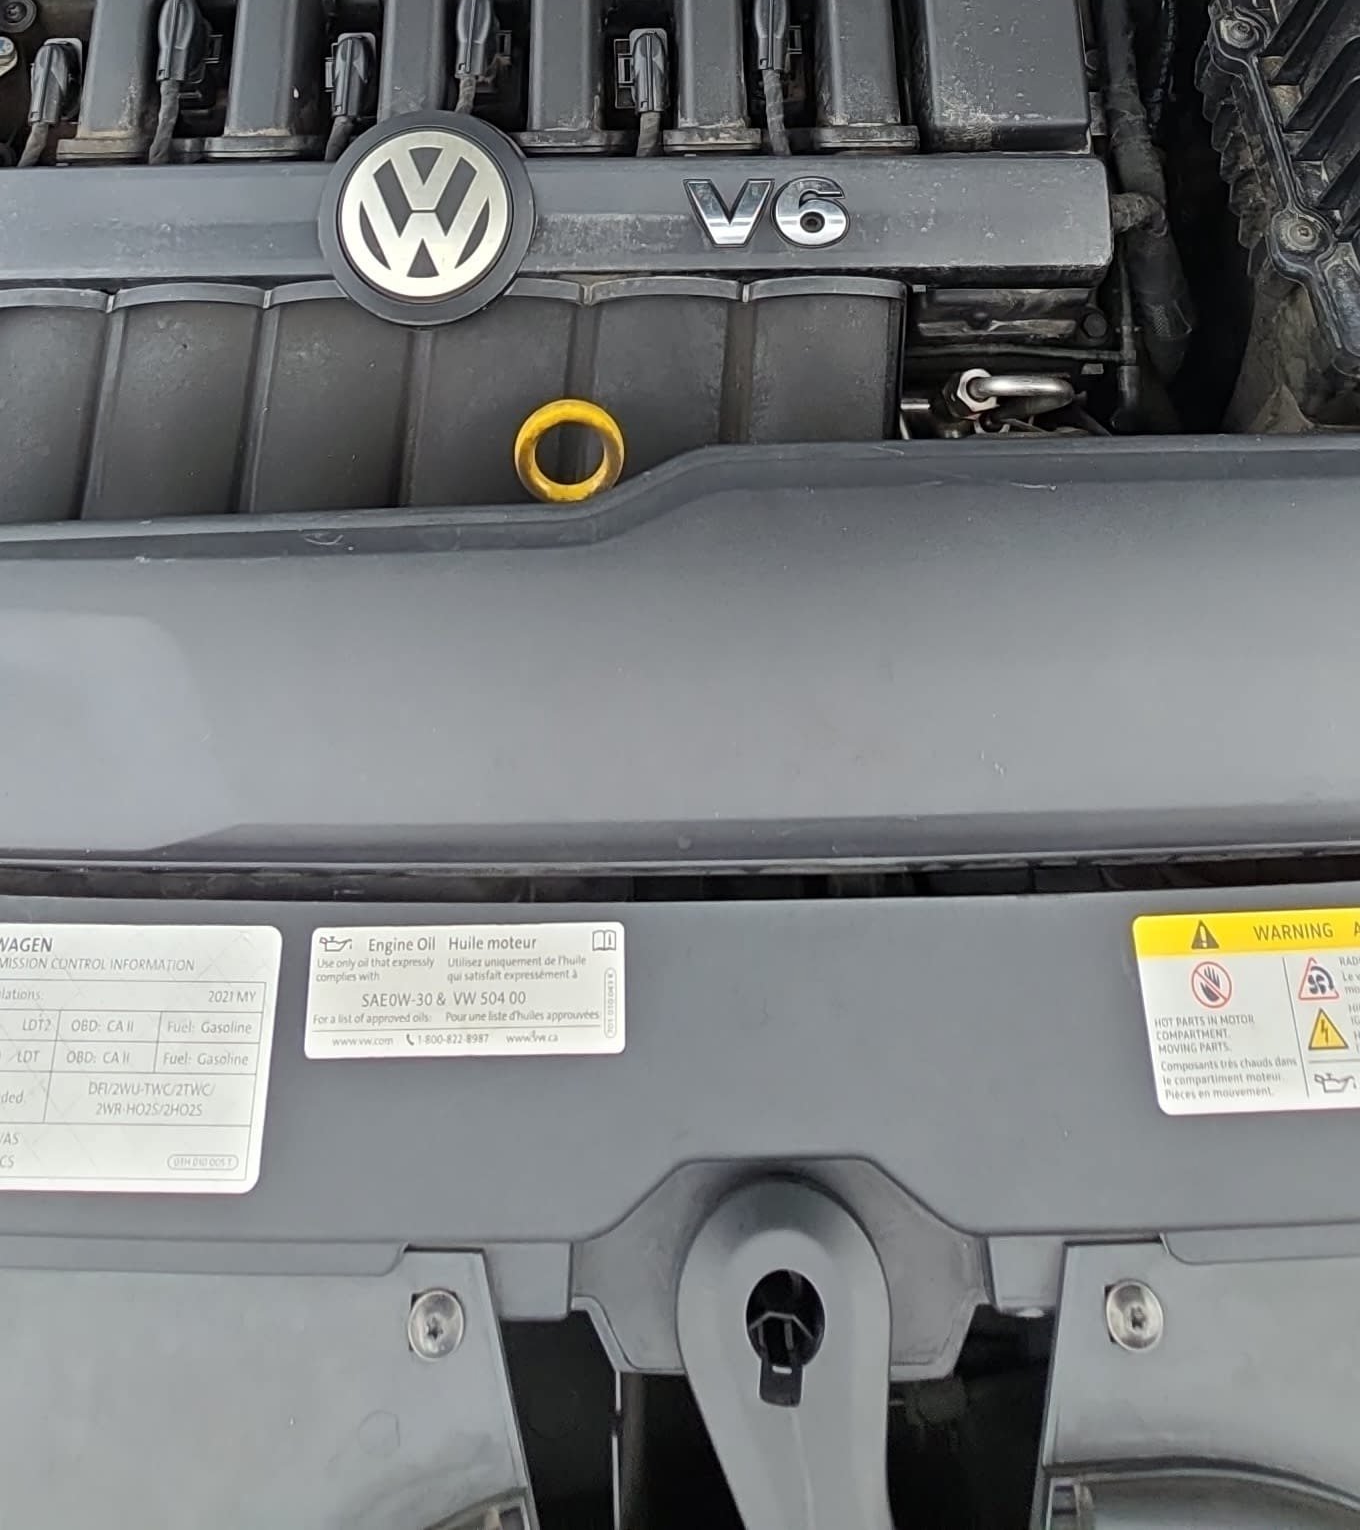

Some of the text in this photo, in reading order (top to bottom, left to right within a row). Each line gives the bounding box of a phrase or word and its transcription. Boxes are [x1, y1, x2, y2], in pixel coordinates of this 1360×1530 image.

[683, 176, 851, 249] V6
[1253, 922, 1334, 940] WARNING
[368, 936, 536, 955] Engine Oil Huile moteur
[50, 958, 106, 970] CONTROL
[109, 958, 195, 971] INFORMATION
[316, 956, 434, 970] Use only oil that expressly
[448, 955, 585, 969] Utilisez uniquement de l'huile
[315, 971, 379, 984] complies with
[207, 990, 256, 1003] 2021 MY
[361, 990, 525, 1007] SAE 0W-30 & VW 504 00
[313, 1014, 327, 1024] For
[338, 1013, 351, 1023] list
[354, 1013, 364, 1023] of
[366, 1013, 410, 1026] approved
[446, 1009, 599, 1022] Pour une liste d'huiles approuvées
[21, 1018, 51, 1031] LDT2
[70, 1019, 101, 1032] OBD:
[106, 1020, 124, 1032] CA
[200, 1020, 252, 1034] Gasoline
[16, 1049, 40, 1062] LDT
[102, 1051, 120, 1064] CA
[196, 1052, 249, 1065] Gasoline
